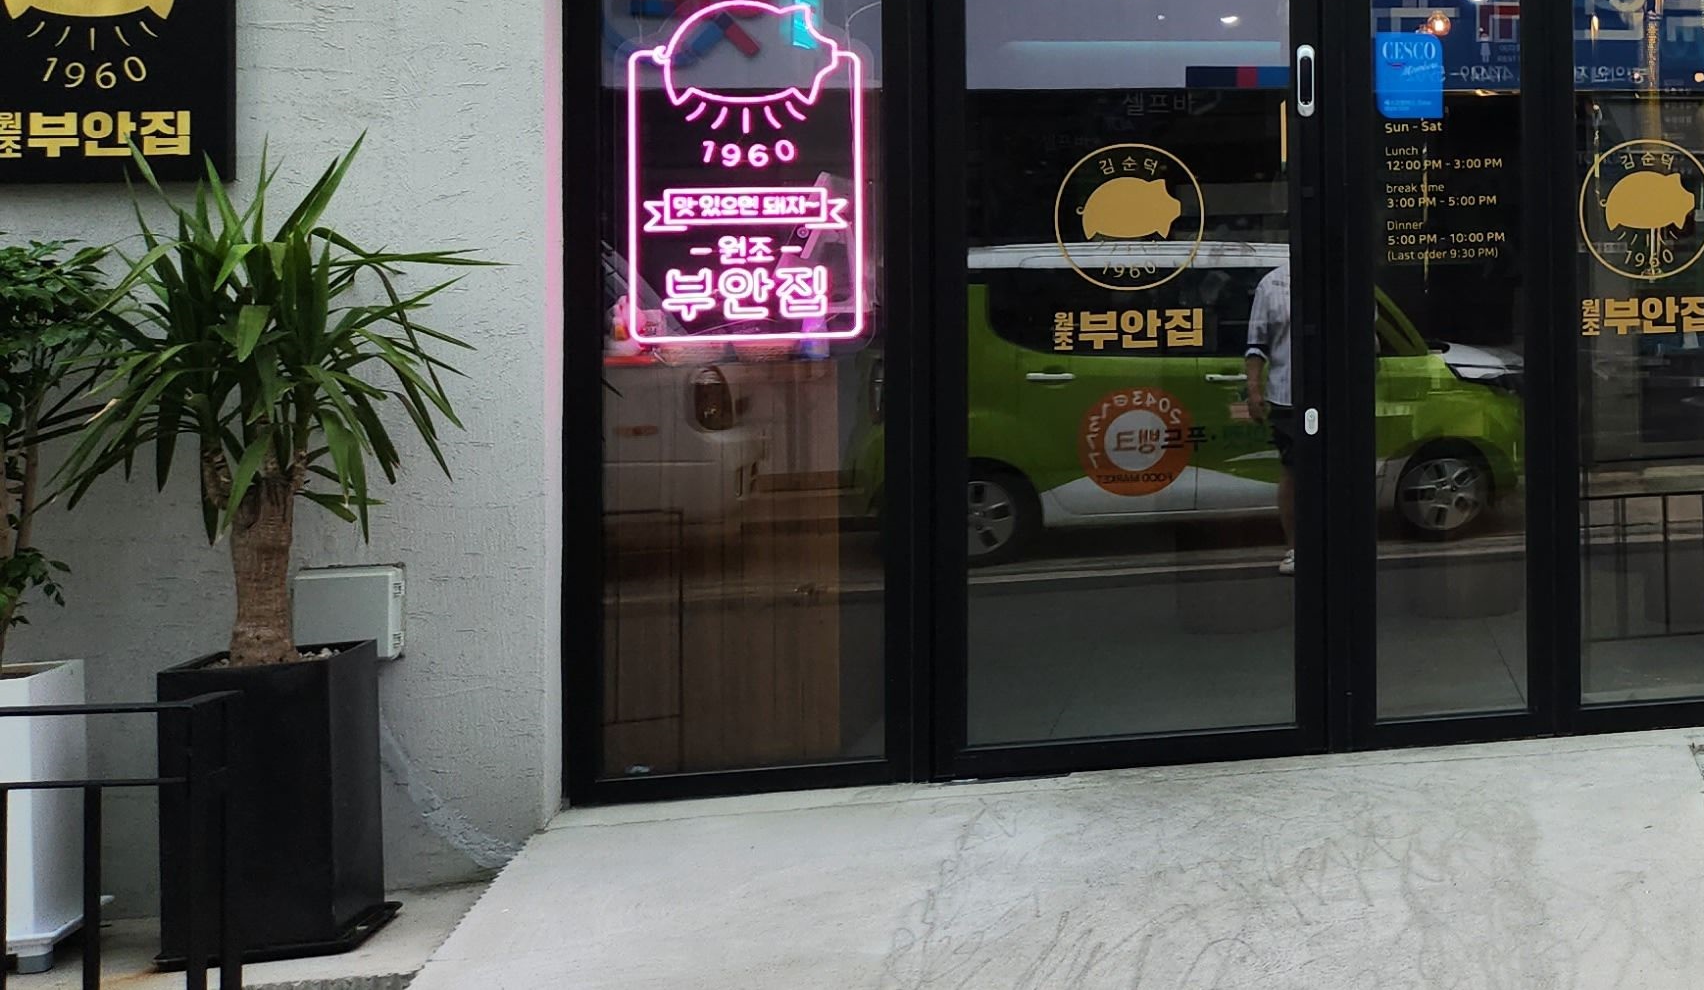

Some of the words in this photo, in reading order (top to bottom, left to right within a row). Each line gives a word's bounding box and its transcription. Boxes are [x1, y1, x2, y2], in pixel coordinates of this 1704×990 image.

[1382, 41, 1436, 59] CESCO
[41, 56, 147, 89] 1960
[27, 110, 191, 158] 부안집
[1385, 122, 1409, 133] Sun
[1421, 121, 1443, 132] Sat
[702, 139, 795, 168] 1960
[1385, 146, 1419, 157] Lunch
[1620, 151, 1676, 170] 김순덕
[1099, 156, 1159, 176] 김순덕
[1387, 160, 1421, 171] 12:00
[1424, 159, 1442, 170] PM
[1454, 159, 1481, 170] 3:00
[1485, 158, 1503, 169] PM
[1386, 183, 1417, 194] break
[1387, 198, 1415, 208] 3:00
[1418, 197, 1437, 207] PM
[1448, 196, 1475, 207] 5:00
[1479, 195, 1497, 206] PM
[1387, 220, 1423, 231] Dinner
[1387, 235, 1415, 246] 5:00
[1419, 234, 1437, 245] PM
[1450, 233, 1483, 244] 10:00
[1487, 232, 1505, 243] PM
[1387, 249, 1415, 261] (Last
[1418, 248, 1447, 260] order
[1450, 248, 1475, 259] 9:30
[1478, 247, 1498, 259] PM)
[1625, 247, 1674, 268] 1960
[662, 265, 828, 321] 부안집
[1078, 308, 1204, 349] 부안집
